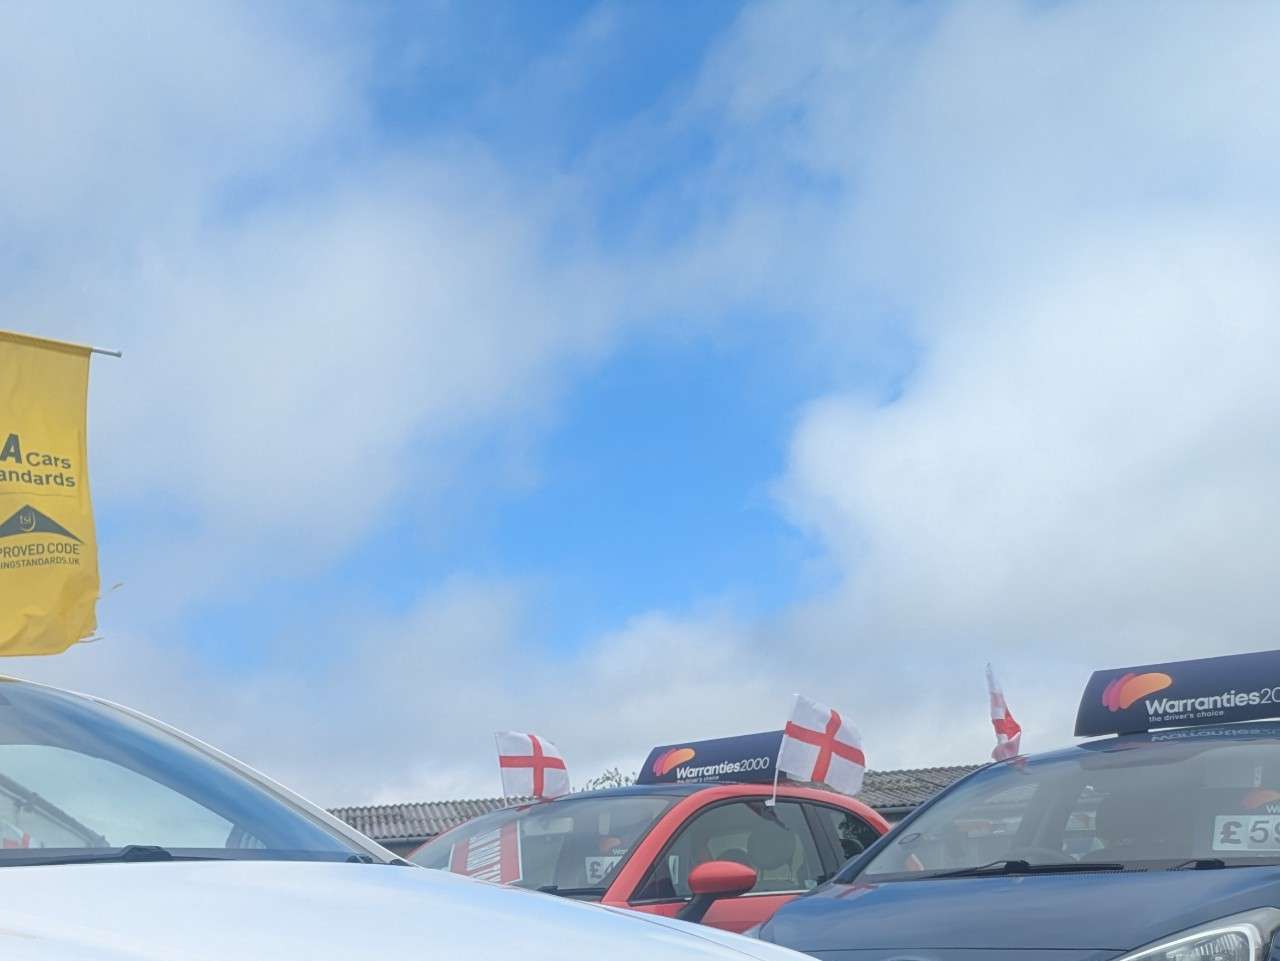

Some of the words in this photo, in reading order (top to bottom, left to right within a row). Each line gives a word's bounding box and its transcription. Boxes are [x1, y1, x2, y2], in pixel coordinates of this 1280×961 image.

[26, 452, 71, 469] Cars
[47, 542, 81, 555] CODE
[676, 757, 770, 779] Warranties2000
